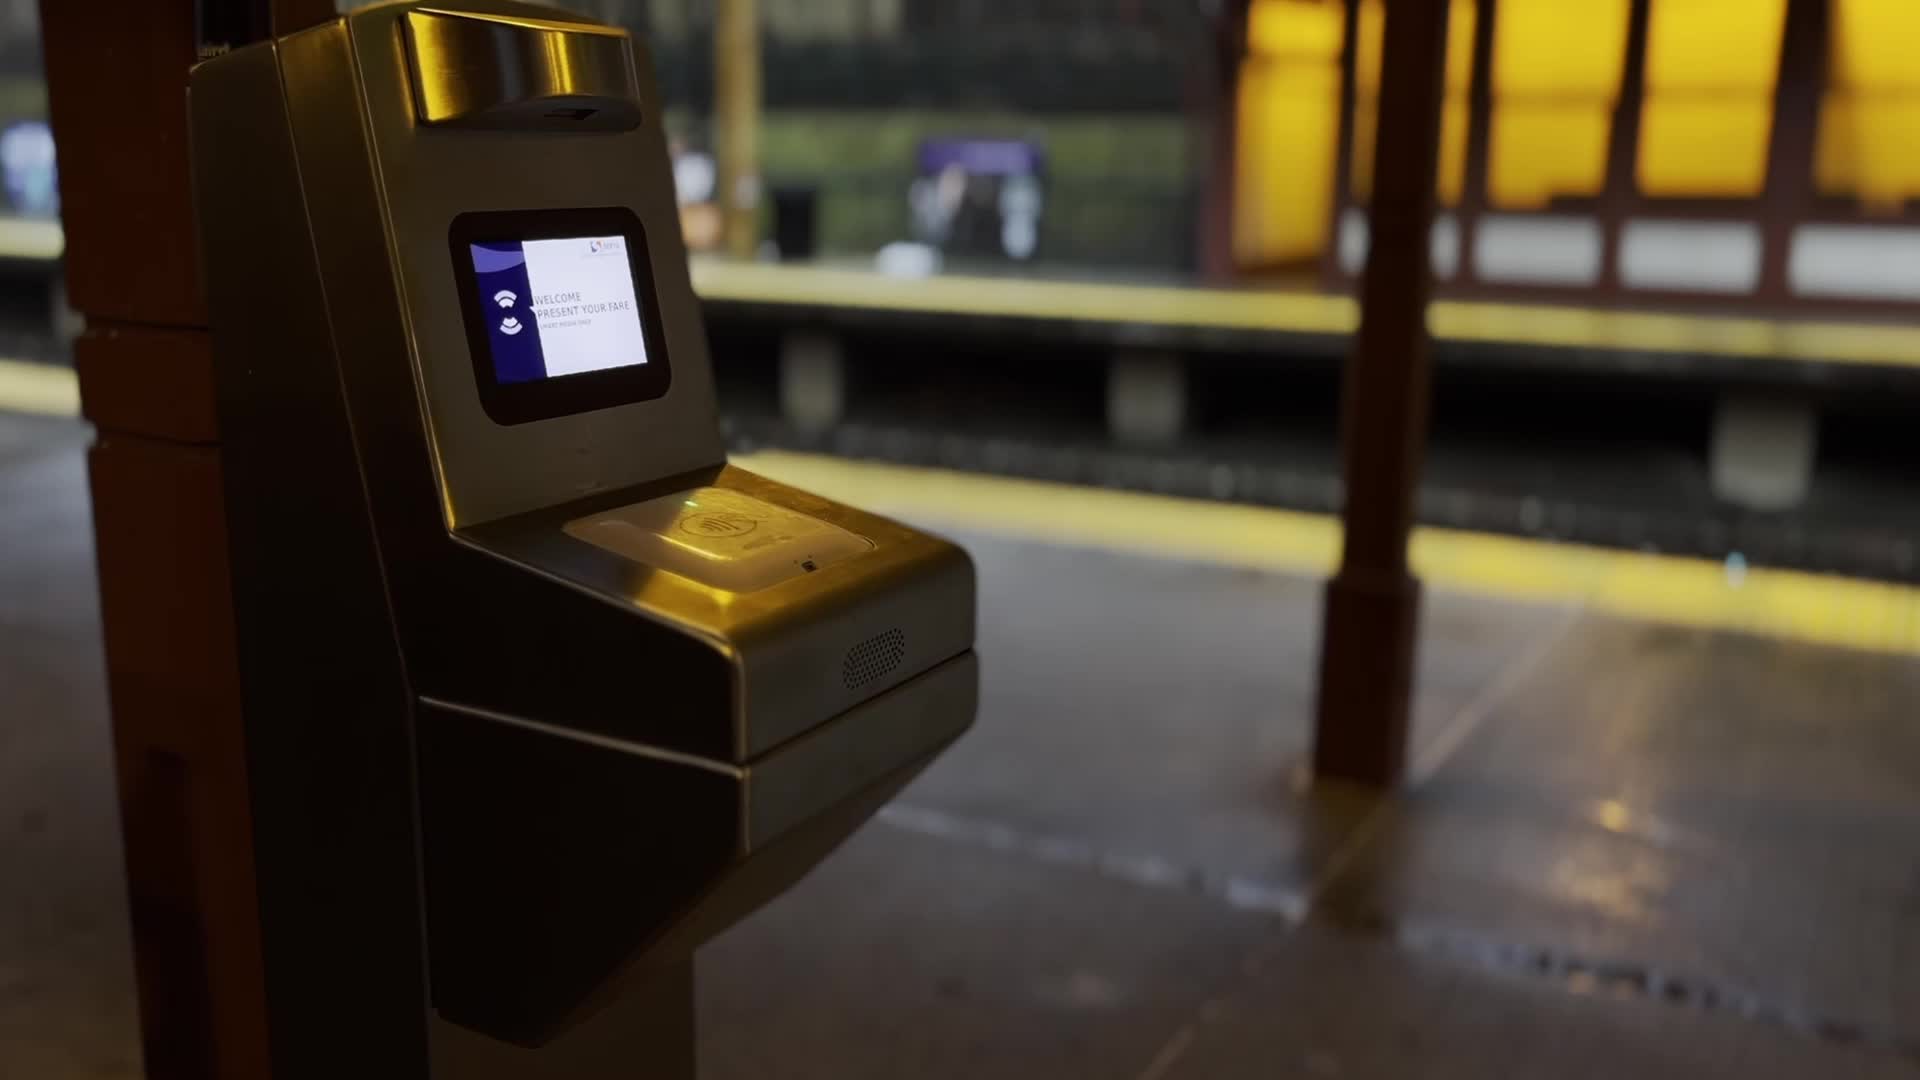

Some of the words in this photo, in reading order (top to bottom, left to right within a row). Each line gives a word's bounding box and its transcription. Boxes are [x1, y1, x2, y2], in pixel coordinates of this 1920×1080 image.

[534, 292, 582, 305] WELCOME
[537, 305, 578, 319] PRESENT
[582, 303, 607, 314] YOUR
[609, 300, 630, 312] FARE
